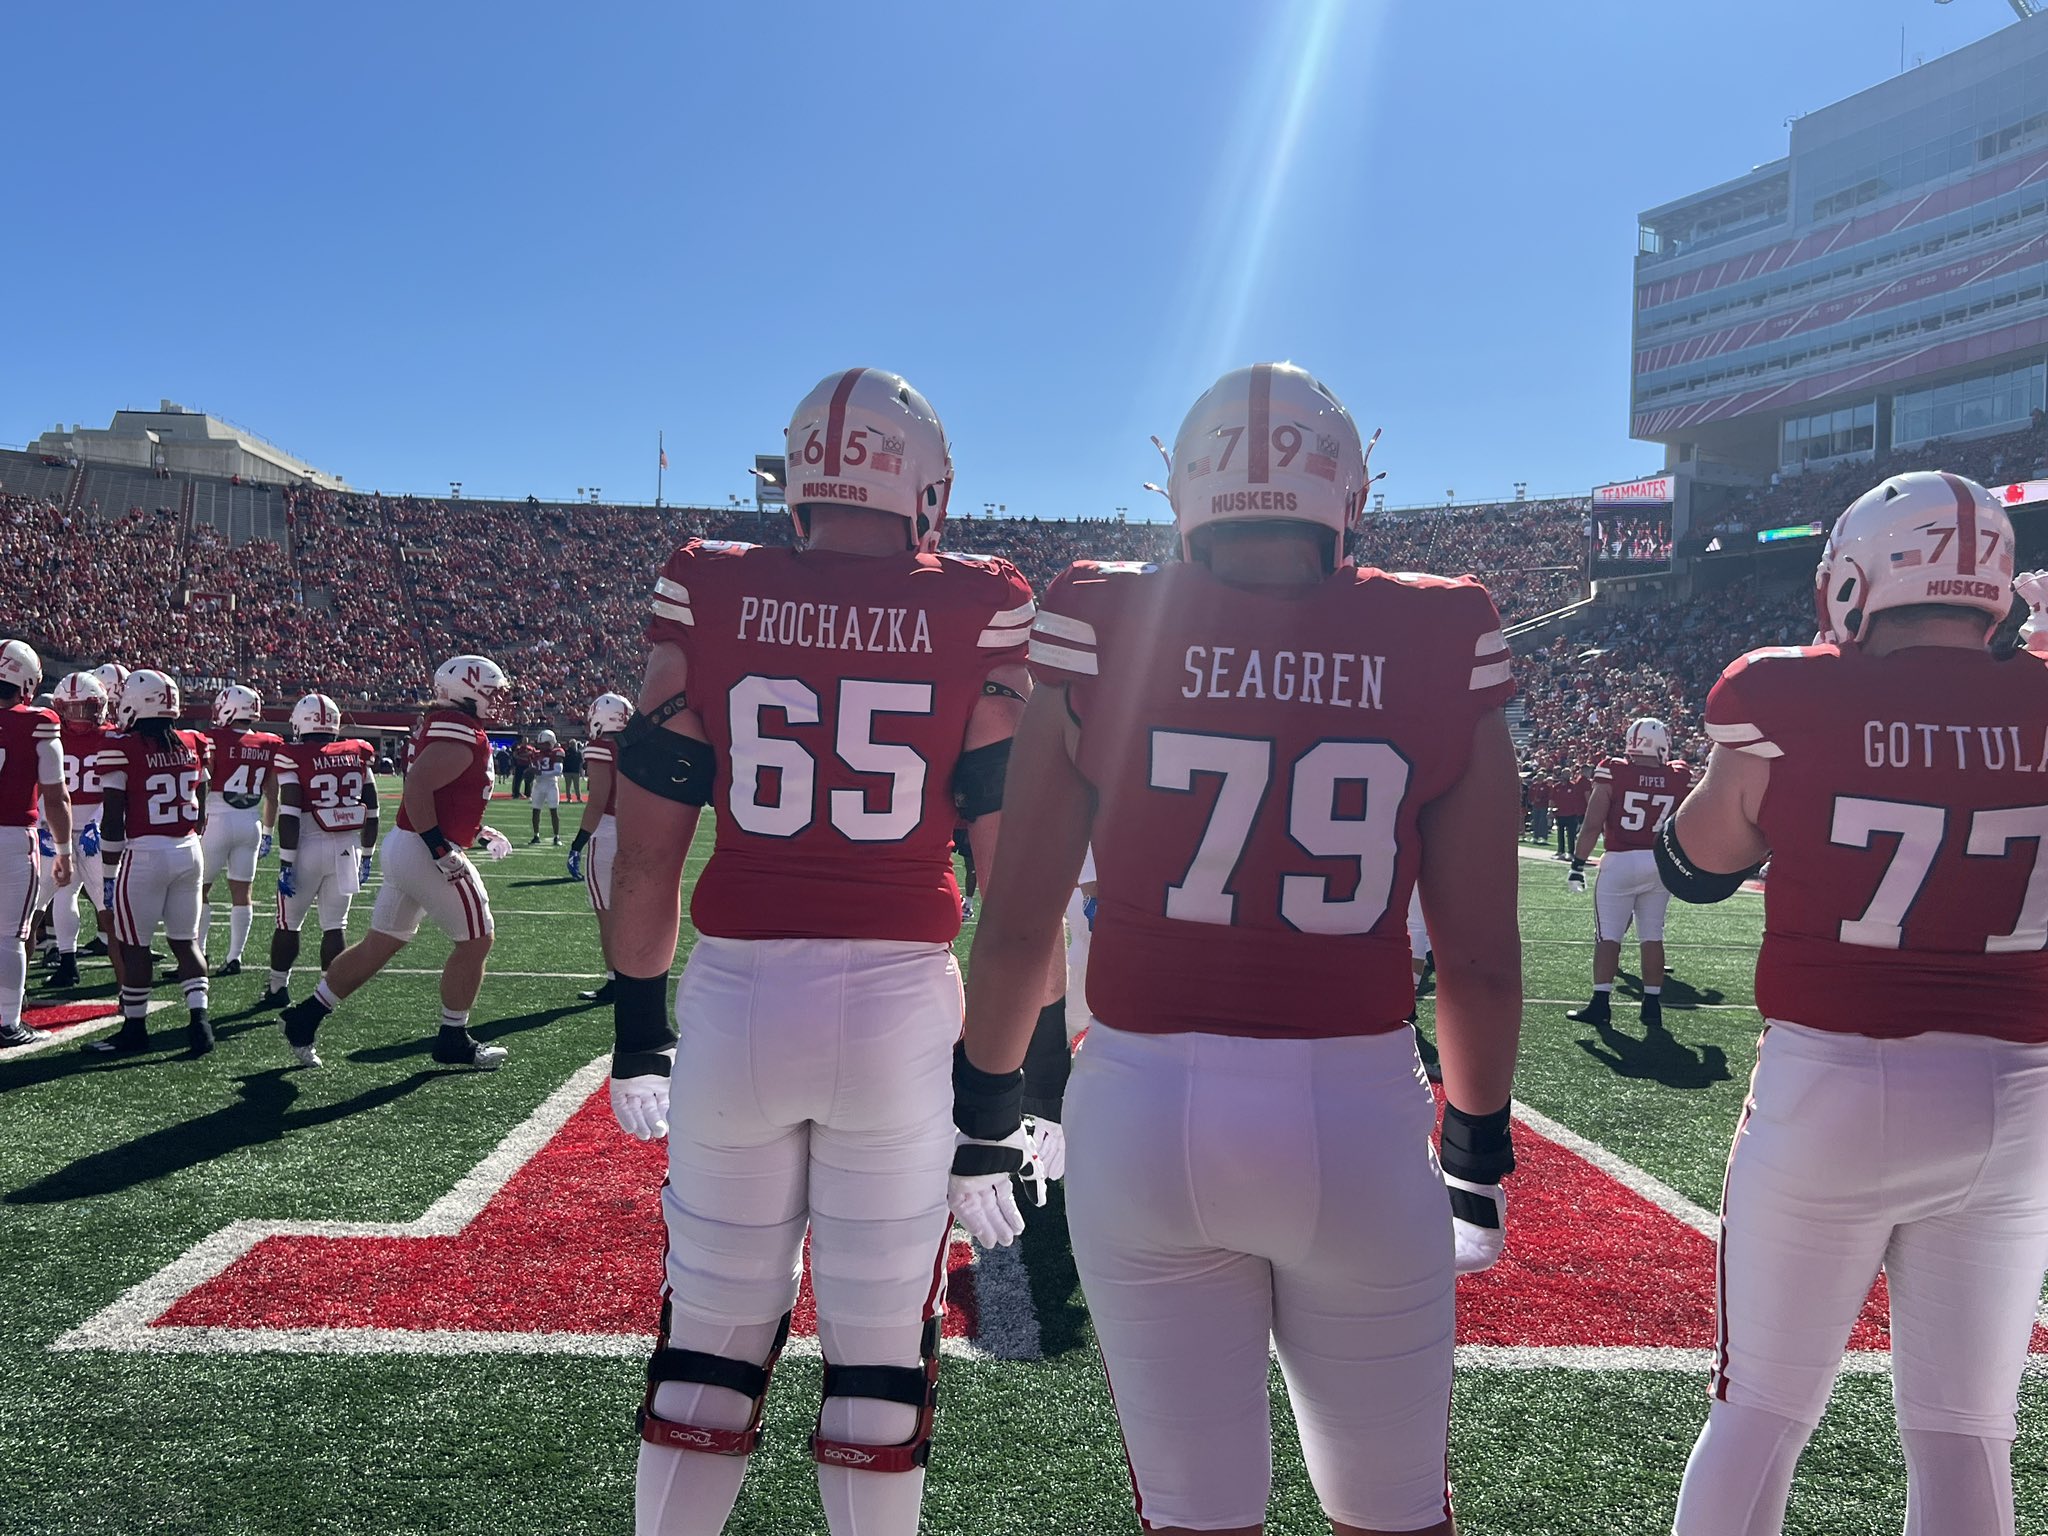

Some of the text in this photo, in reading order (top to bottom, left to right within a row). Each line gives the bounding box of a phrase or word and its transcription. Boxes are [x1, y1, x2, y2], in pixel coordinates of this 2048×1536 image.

[804, 429, 868, 466] 65
[1216, 425, 1303, 472] 79
[802, 482, 868, 503] HUSKERS
[1211, 491, 1298, 514] HUSKERS
[1601, 479, 1666, 502] TEAMMATES
[1926, 527, 2000, 565] 77
[1926, 580, 2000, 601] HUSKERS
[737, 596, 933, 654] PROCHAZKA
[1181, 645, 1386, 710] SEAGREN
[313, 712, 332, 723] 33
[241, 747, 270, 761] BROWN
[728, 674, 934, 842] 65
[145, 770, 200, 825] 25
[223, 764, 267, 795] 41
[309, 771, 363, 808] 33
[1638, 774, 1666, 788] PIPER
[1620, 790, 1675, 833] 57
[1149, 729, 1411, 936] 79
[1662, 830, 1693, 878] Mueller
[1829, 795, 2048, 954] 77
[824, 1446, 878, 1464] DONJOY
